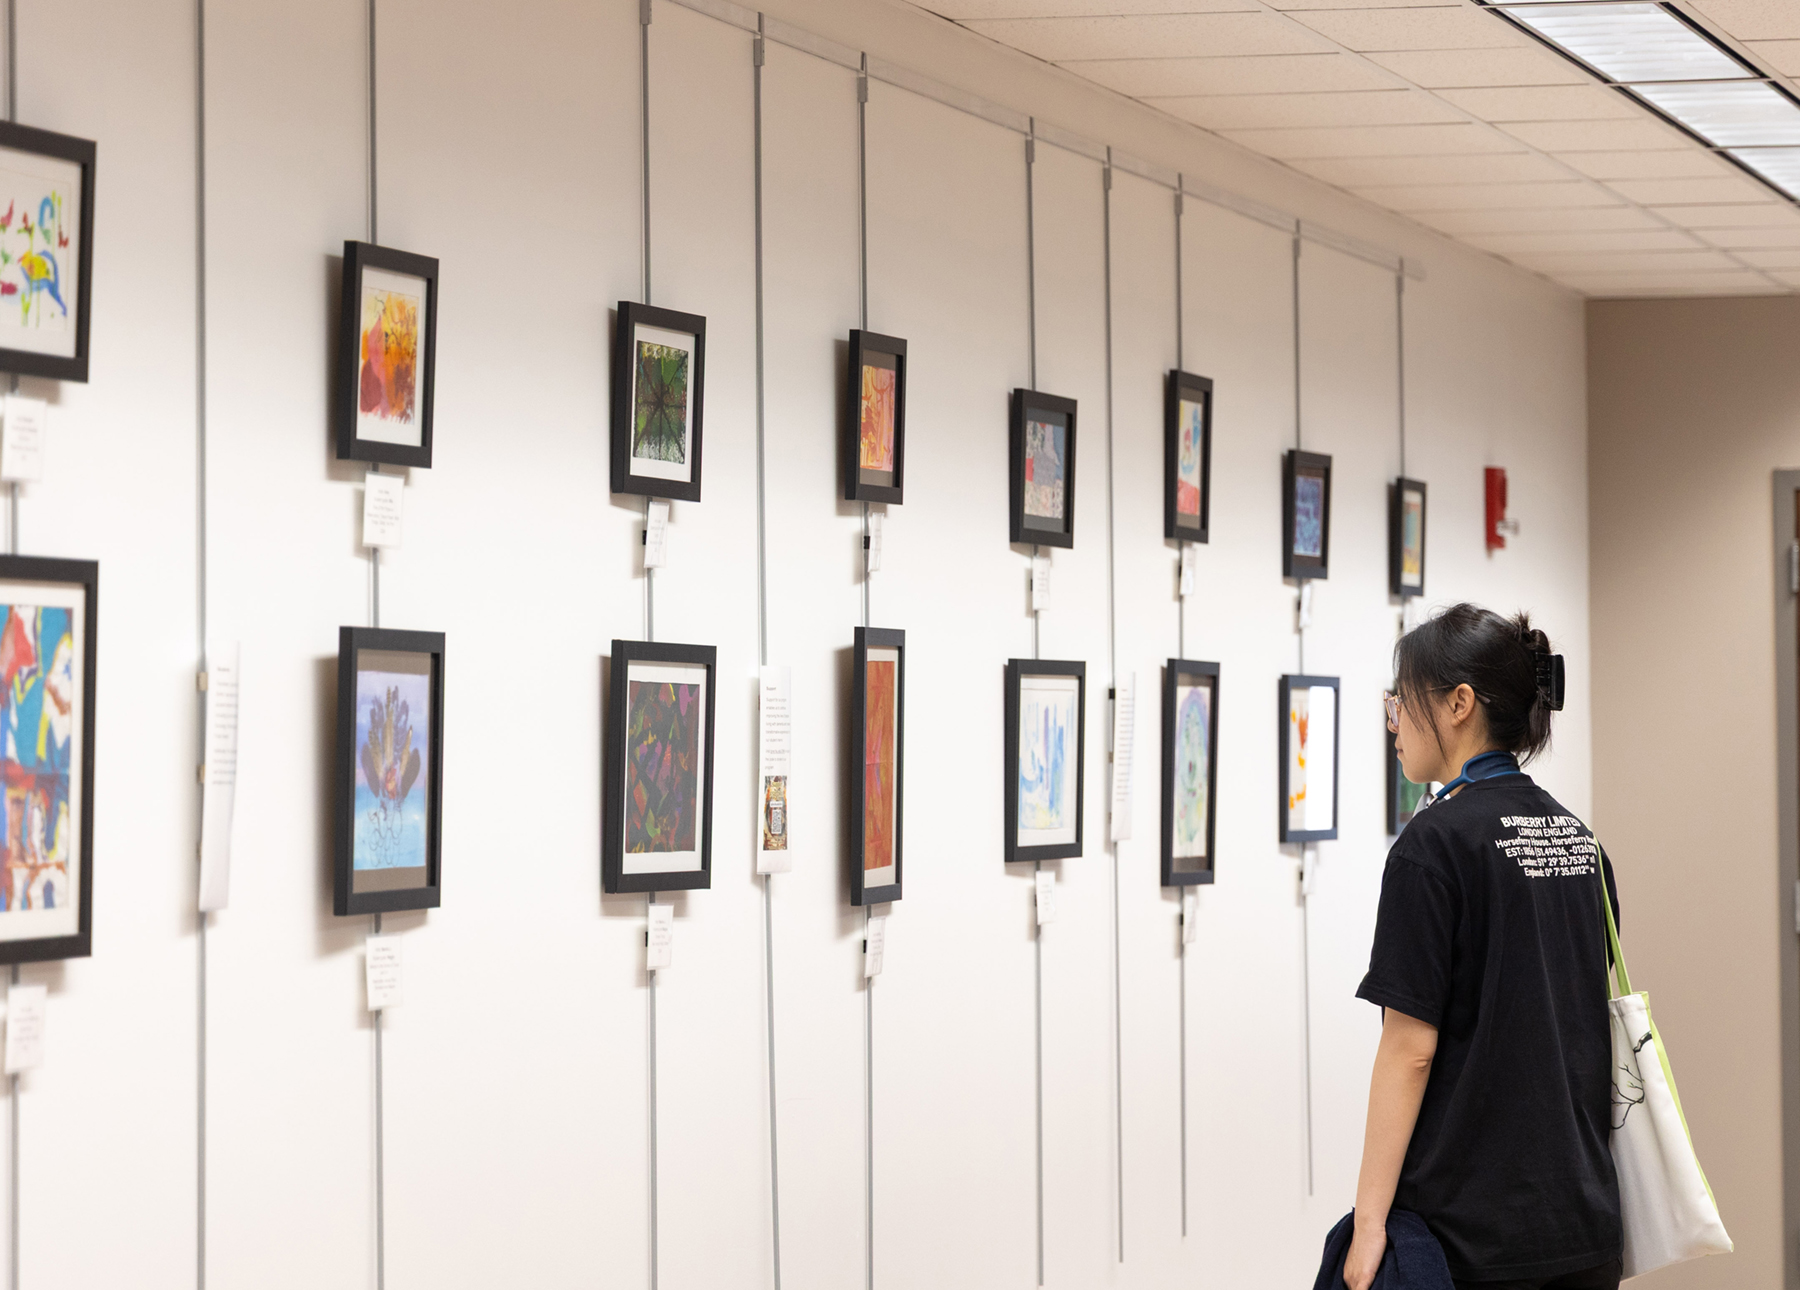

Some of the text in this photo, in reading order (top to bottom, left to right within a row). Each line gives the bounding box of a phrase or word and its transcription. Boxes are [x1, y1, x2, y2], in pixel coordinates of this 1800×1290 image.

[1500, 816, 1581, 827] BURBERRY LIMITED
[1517, 827, 1577, 838] LONDON ENGLAND
[1551, 836, 1587, 847] Horseferry
[1505, 848, 1524, 858] EST:
